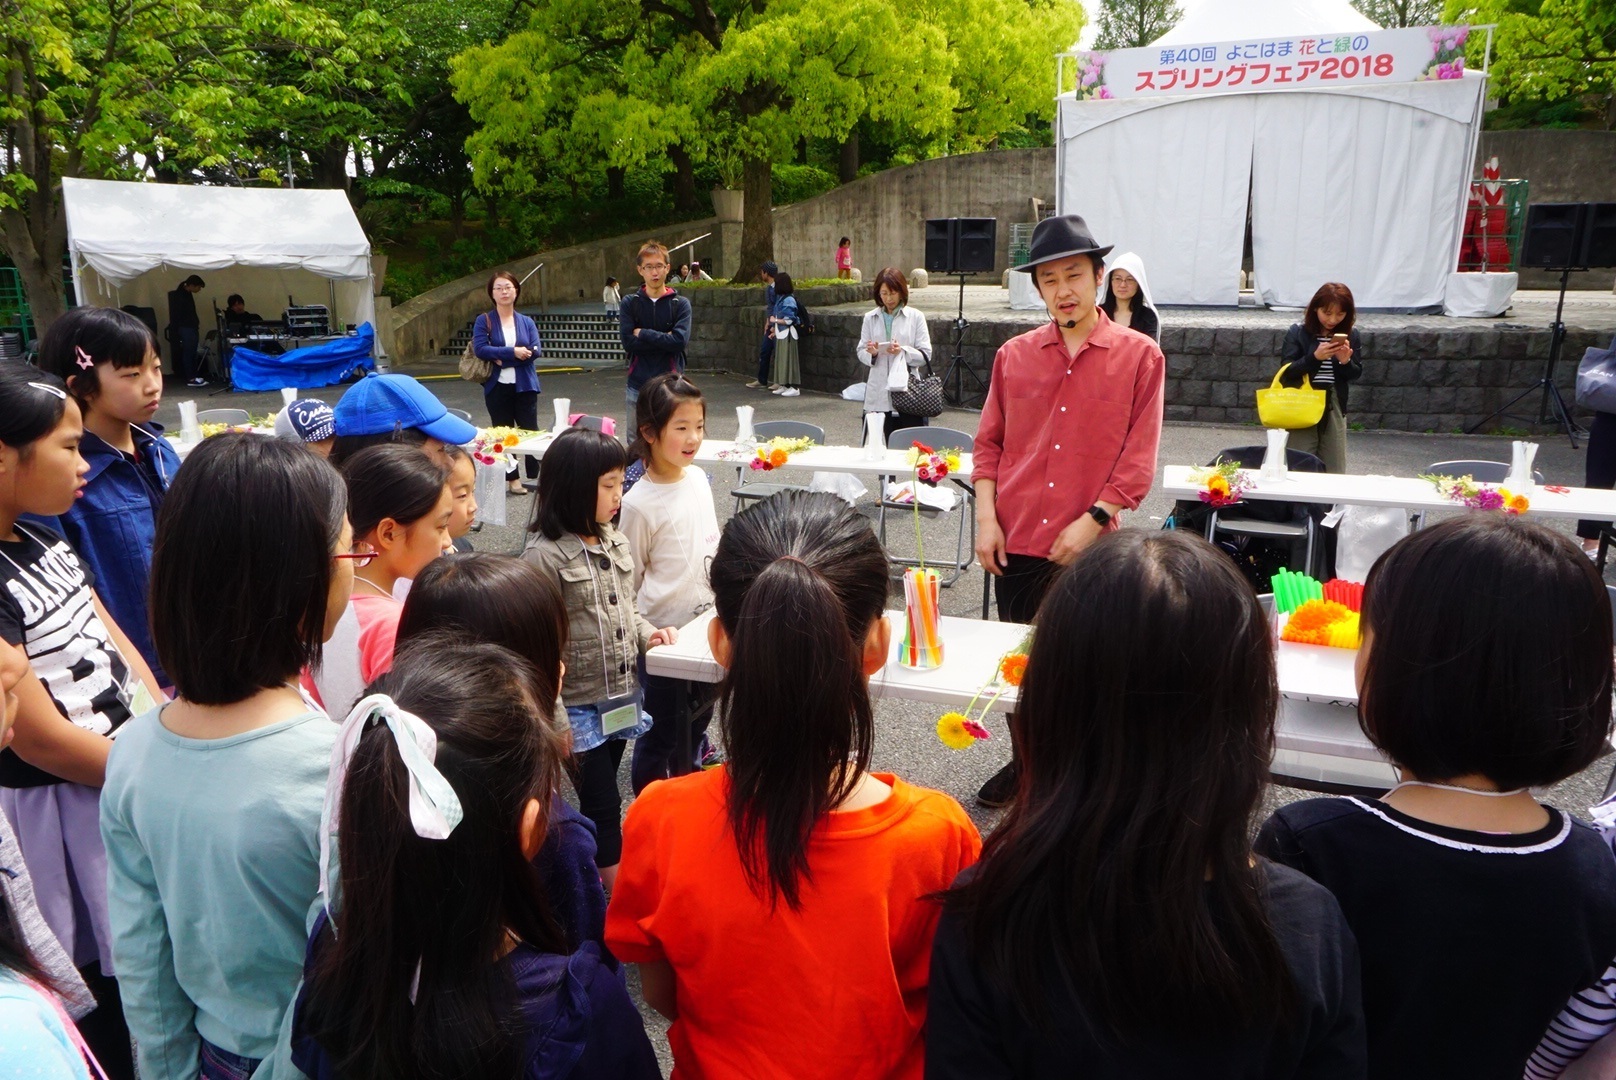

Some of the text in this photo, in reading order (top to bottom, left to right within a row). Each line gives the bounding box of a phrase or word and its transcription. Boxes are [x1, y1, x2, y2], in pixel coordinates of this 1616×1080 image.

[1160, 35, 1369, 65] 第40回 よこはま 花と緑の
[1135, 53, 1394, 91] スプリングフェア2018
[6, 541, 86, 626] DANCE
